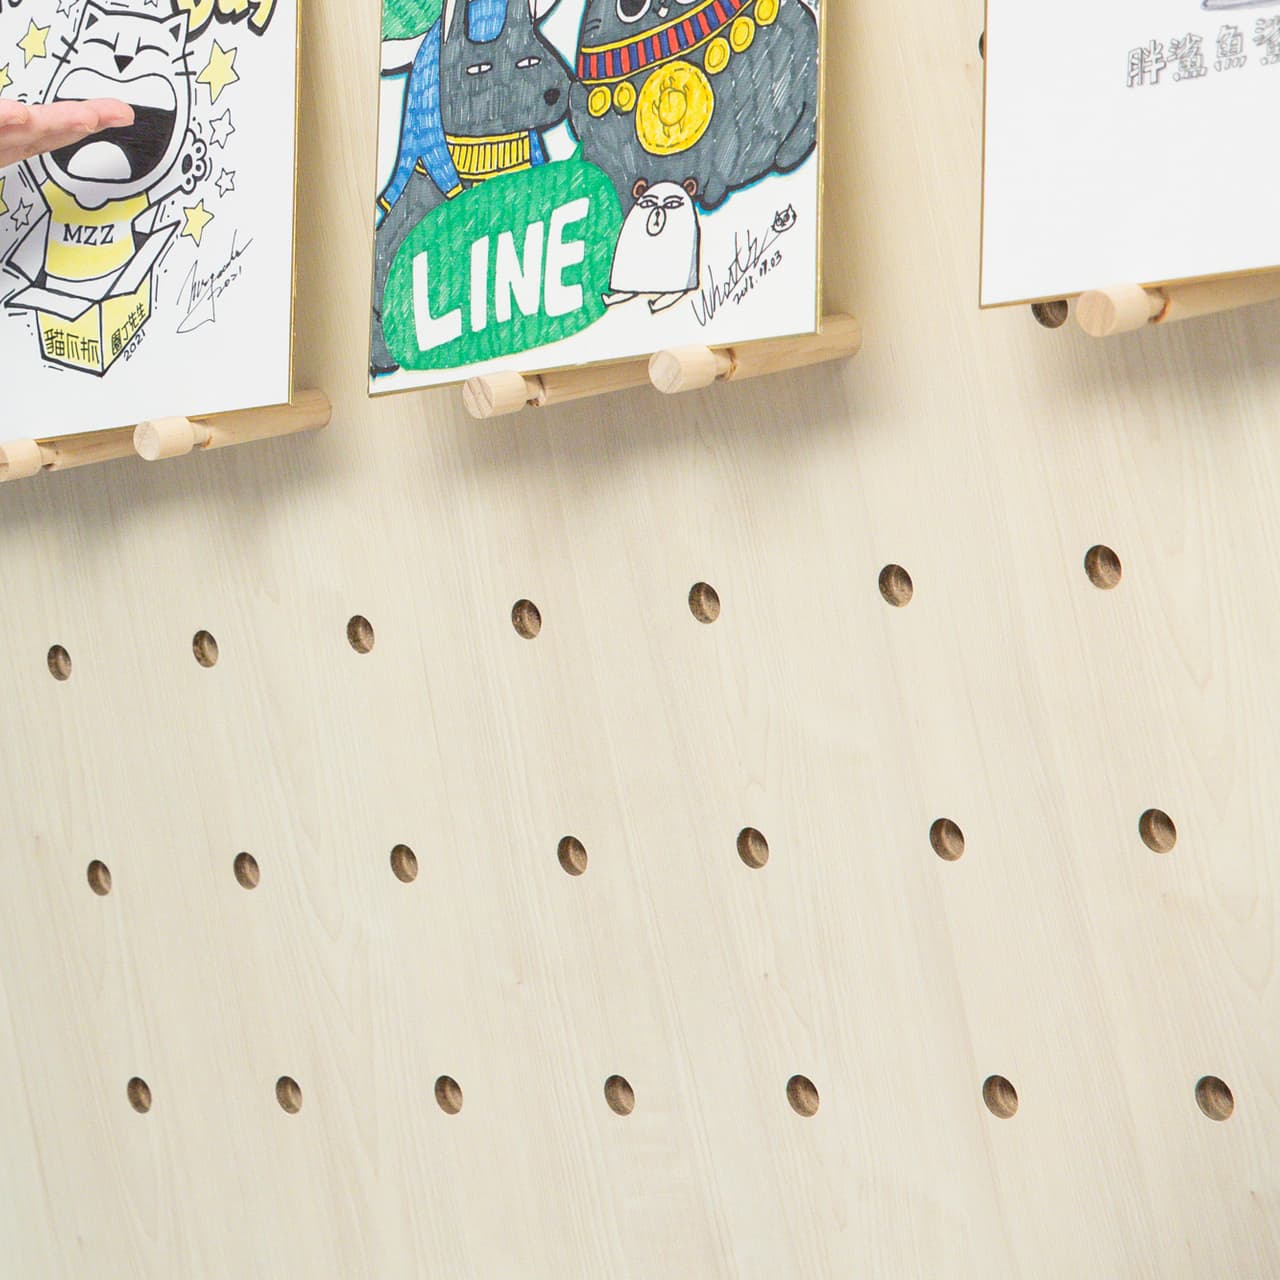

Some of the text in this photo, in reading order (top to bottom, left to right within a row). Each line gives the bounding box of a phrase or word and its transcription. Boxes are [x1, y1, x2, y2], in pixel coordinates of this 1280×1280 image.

[63, 223, 115, 246] MZZ
[412, 197, 591, 352] LINE
[123, 327, 147, 362] 2021
